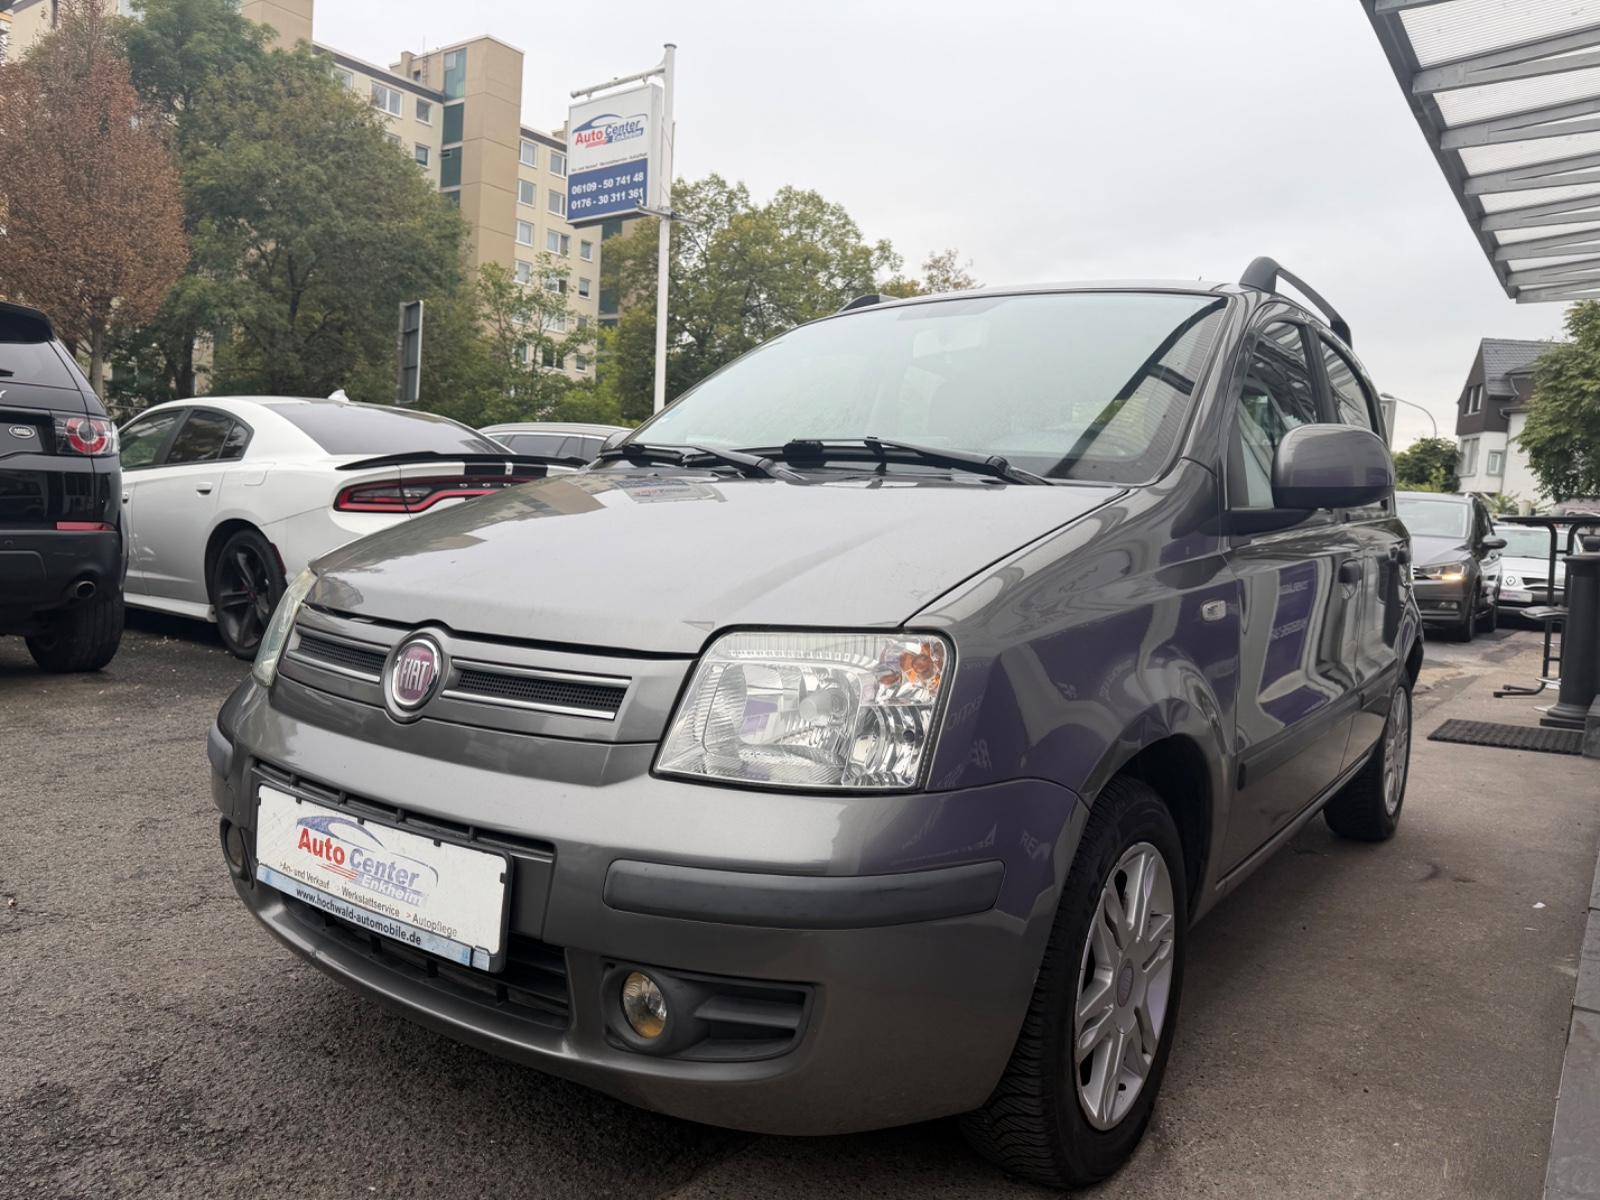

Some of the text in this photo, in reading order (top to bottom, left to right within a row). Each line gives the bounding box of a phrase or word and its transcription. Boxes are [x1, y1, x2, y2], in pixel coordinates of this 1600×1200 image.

[575, 129, 604, 145] Auto
[605, 120, 640, 136] Center
[571, 182, 597, 195] 06109
[603, 178, 614, 189] 50
[616, 175, 631, 186] 741
[633, 171, 644, 182] 48
[571, 197, 592, 210] 0176
[598, 195, 609, 204] 30
[610, 191, 626, 202] 311
[400, 658, 430, 691] FIAT
[298, 828, 420, 888] Auto Center
[306, 871, 330, 889] Verkauf
[341, 885, 400, 917] Werkstattservice
[412, 913, 458, 938] Autopflege
[361, 875, 422, 905] Enkheim
[296, 888, 422, 946] www.hochwald-automobile.de
